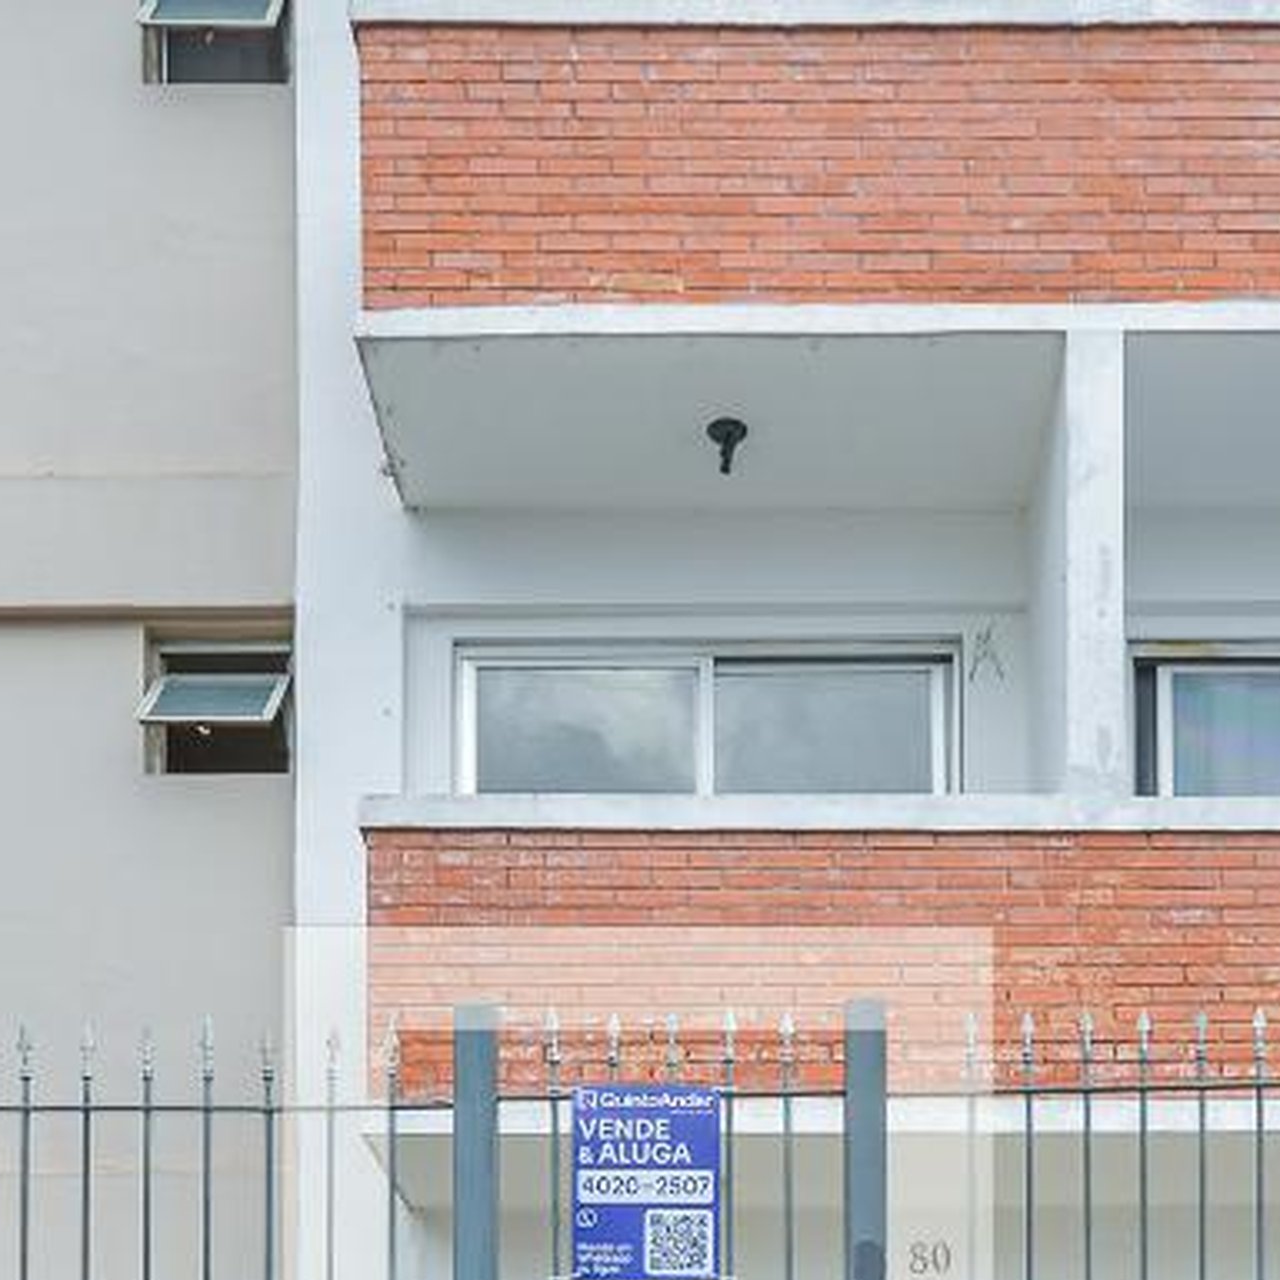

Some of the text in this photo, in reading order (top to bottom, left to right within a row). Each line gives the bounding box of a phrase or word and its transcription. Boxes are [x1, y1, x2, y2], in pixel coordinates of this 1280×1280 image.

[579, 1118, 671, 1140] VENDE
[579, 1142, 692, 1164] & ALUGA
[909, 1241, 951, 1275] 80
